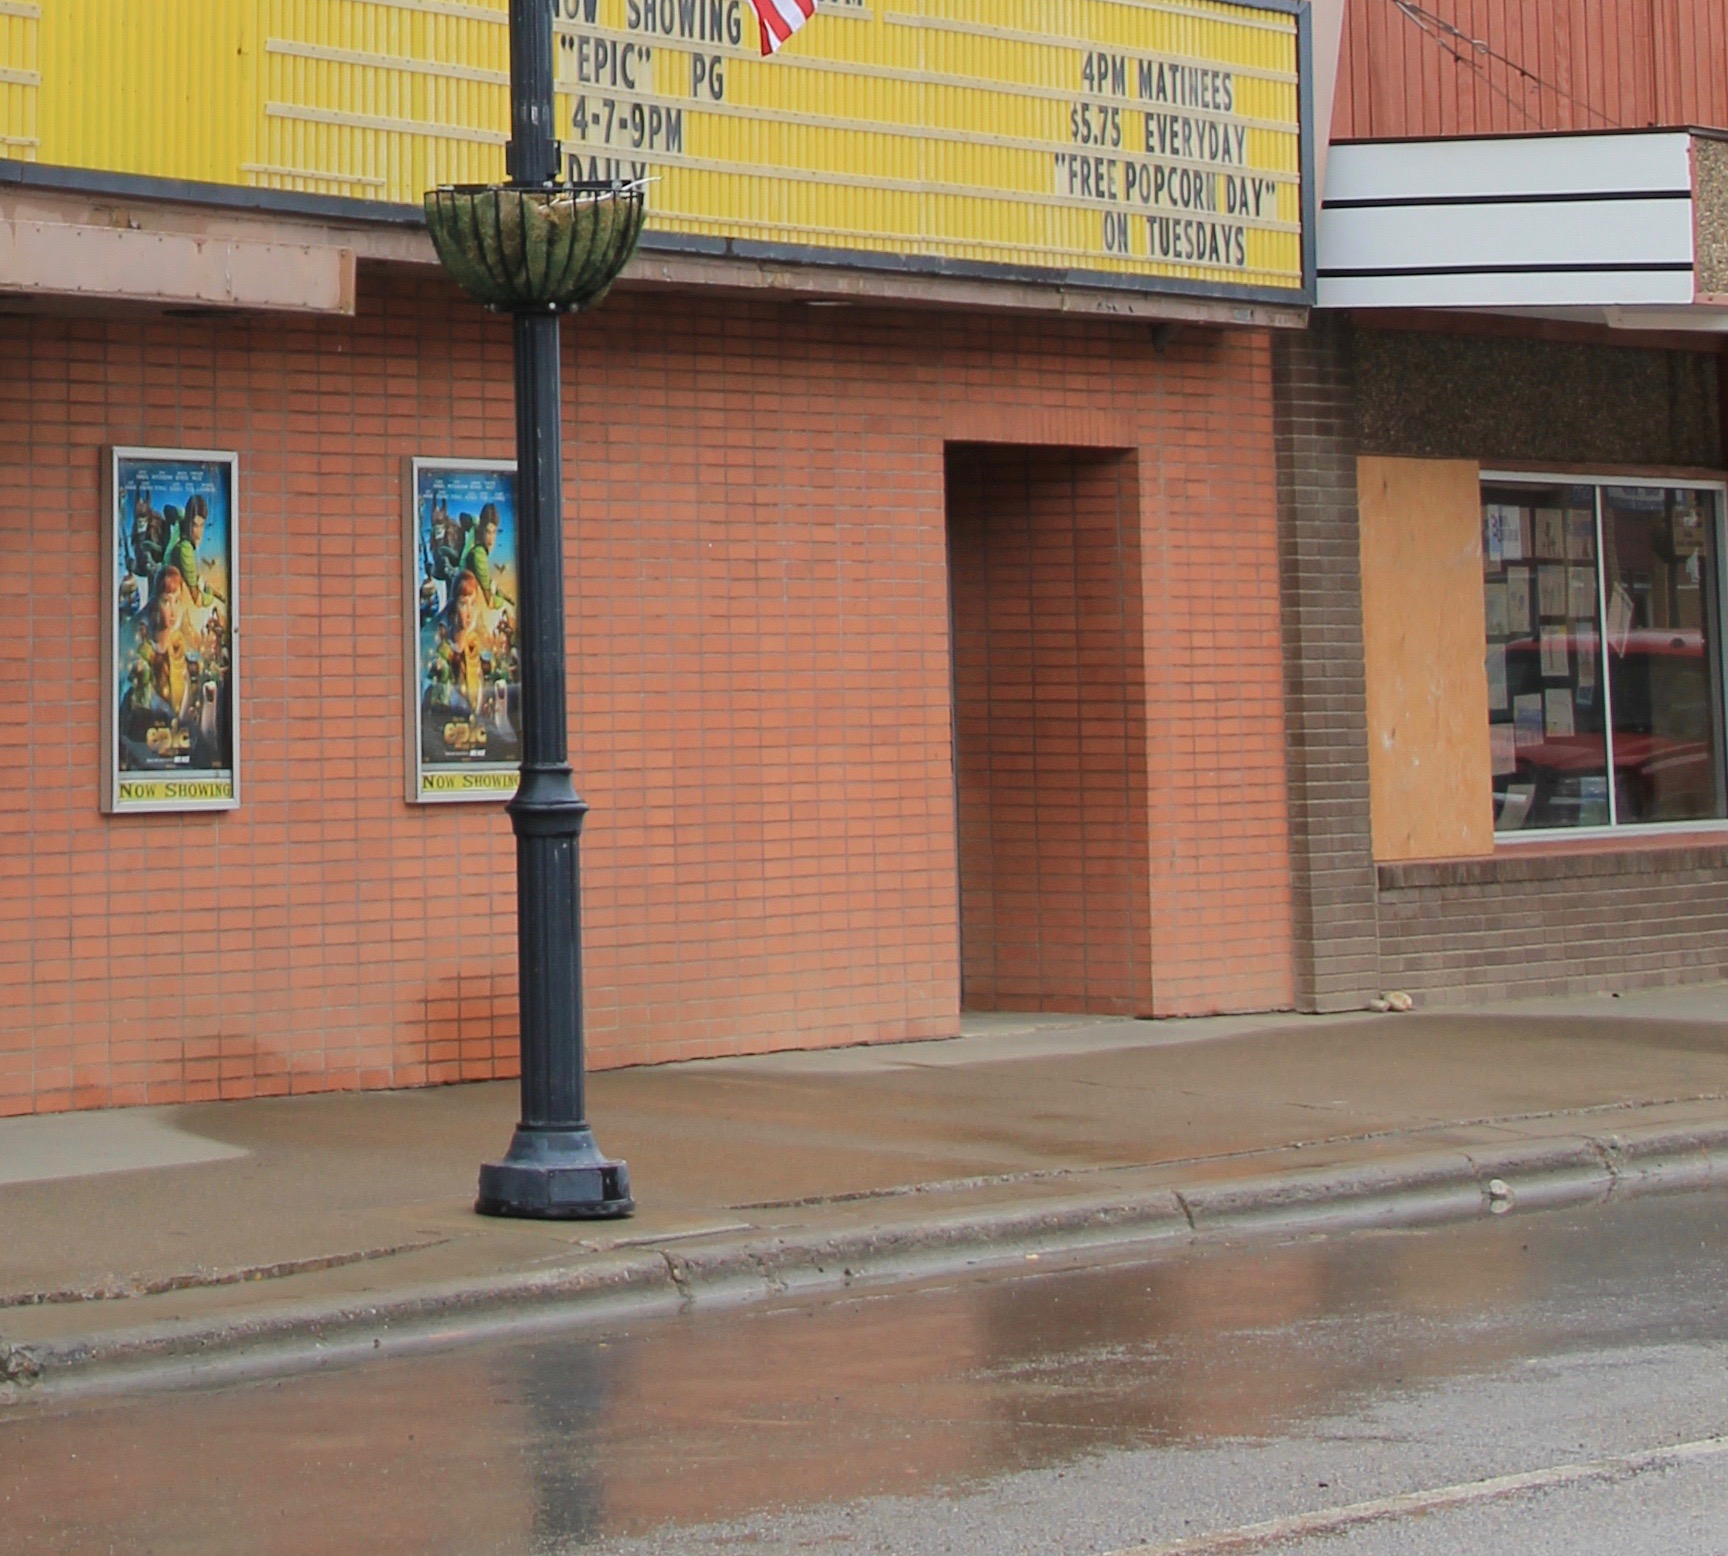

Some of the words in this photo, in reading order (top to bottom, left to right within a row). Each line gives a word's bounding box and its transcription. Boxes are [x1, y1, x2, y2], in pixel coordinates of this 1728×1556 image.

[693, 52, 723, 100] PG
[1083, 51, 1126, 96] 4PM
[1138, 58, 1233, 113] MATINEES
[573, 95, 682, 153] 4-7-9PM
[1071, 102, 1121, 148] $5.75
[1144, 112, 1245, 165] EVERYDAY
[1125, 161, 1217, 212] POPCORN
[1104, 210, 1129, 254] ON
[1146, 216, 1245, 267] TUESDAYS
[146, 717, 191, 757] epic
[443, 713, 487, 750] epic
[119, 783, 156, 799] NOW
[165, 782, 231, 799] SHOWING
[422, 774, 455, 789] NOW
